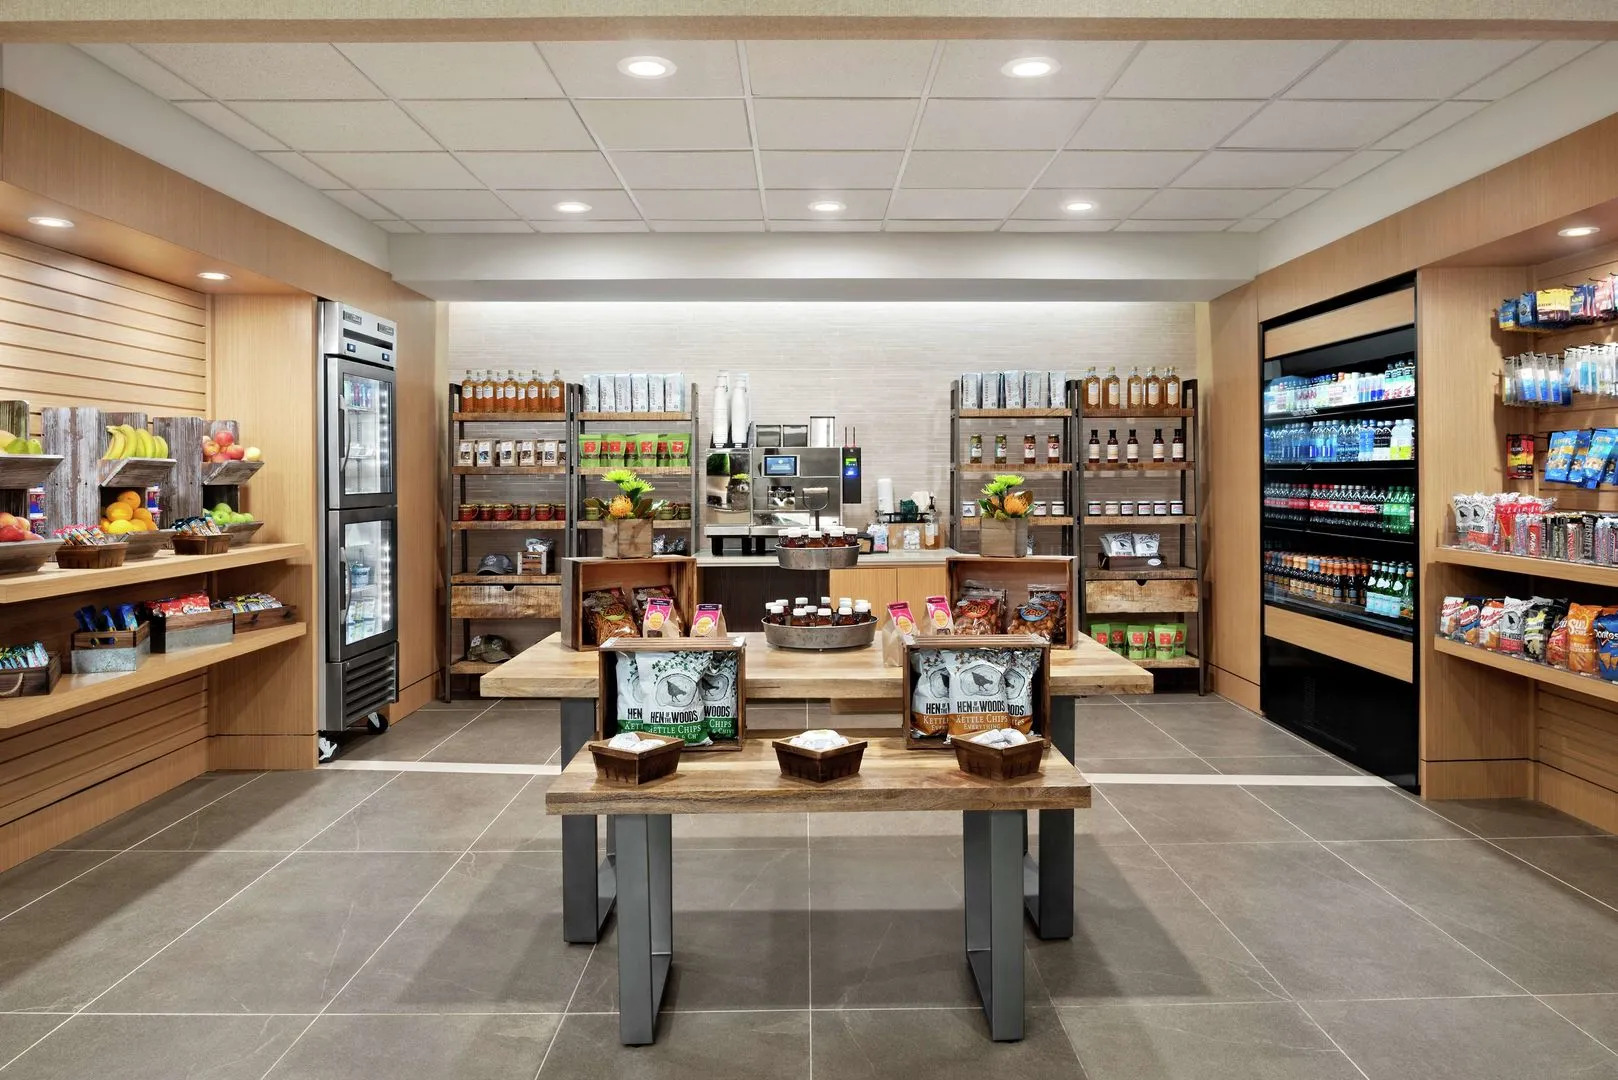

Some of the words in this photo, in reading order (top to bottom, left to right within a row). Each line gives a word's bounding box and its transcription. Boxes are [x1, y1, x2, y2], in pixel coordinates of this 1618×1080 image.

[704, 705, 730, 717] WOODS
[926, 703, 941, 714] HEN
[957, 701, 972, 713] HEN
[979, 700, 1006, 712] WOODS
[627, 708, 643, 719] HEN
[650, 712, 664, 723] HEN
[671, 709, 698, 723] WOODS
[677, 725, 702, 734] CHIPS
